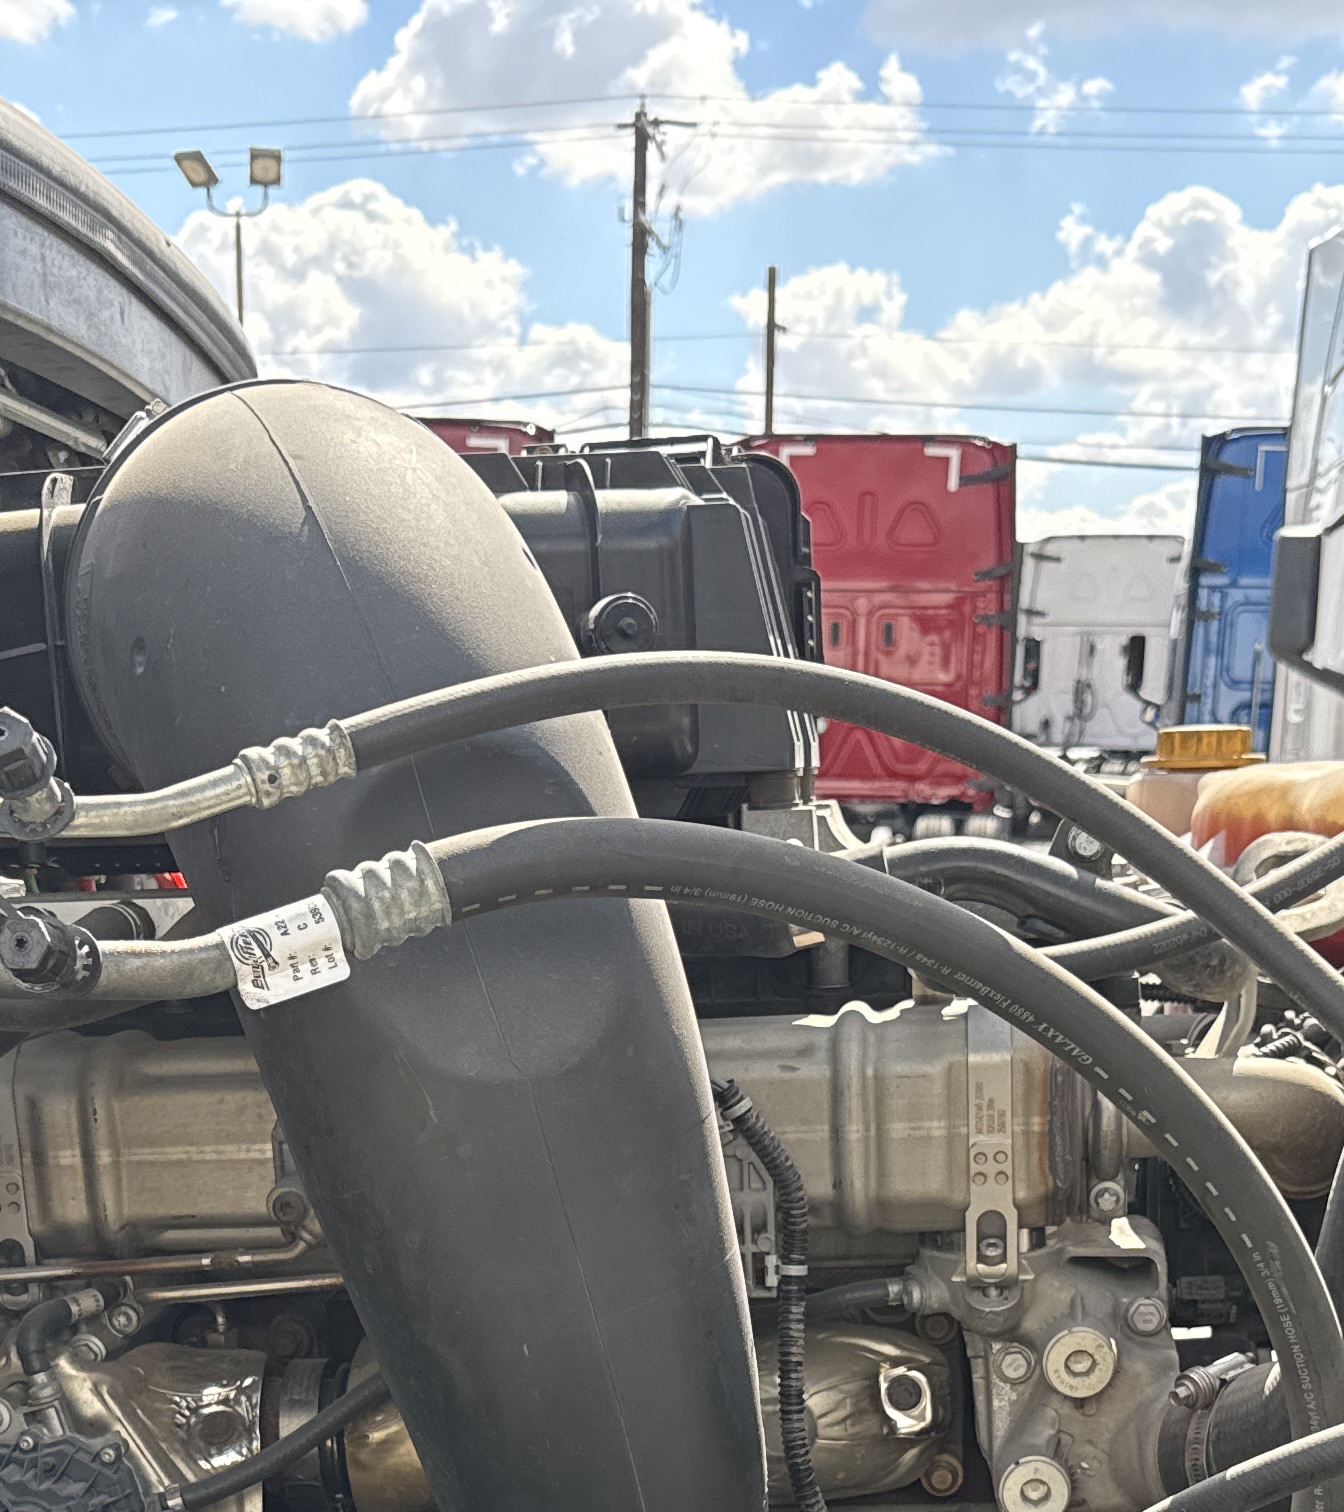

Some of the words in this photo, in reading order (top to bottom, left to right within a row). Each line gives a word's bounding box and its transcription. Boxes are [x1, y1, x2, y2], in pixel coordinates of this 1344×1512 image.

[682, 885, 702, 898] 3/4
[704, 886, 748, 902] (19mm)
[747, 896, 785, 914] HOSE
[785, 904, 841, 931] SUCTION
[839, 922, 859, 937] A/C
[1008, 1004, 1036, 1024] 4880
[1037, 1022, 1093, 1066] GALAXY
[1280, 1314, 1299, 1344] HOSE
[1291, 1344, 1314, 1392] SUCTION
